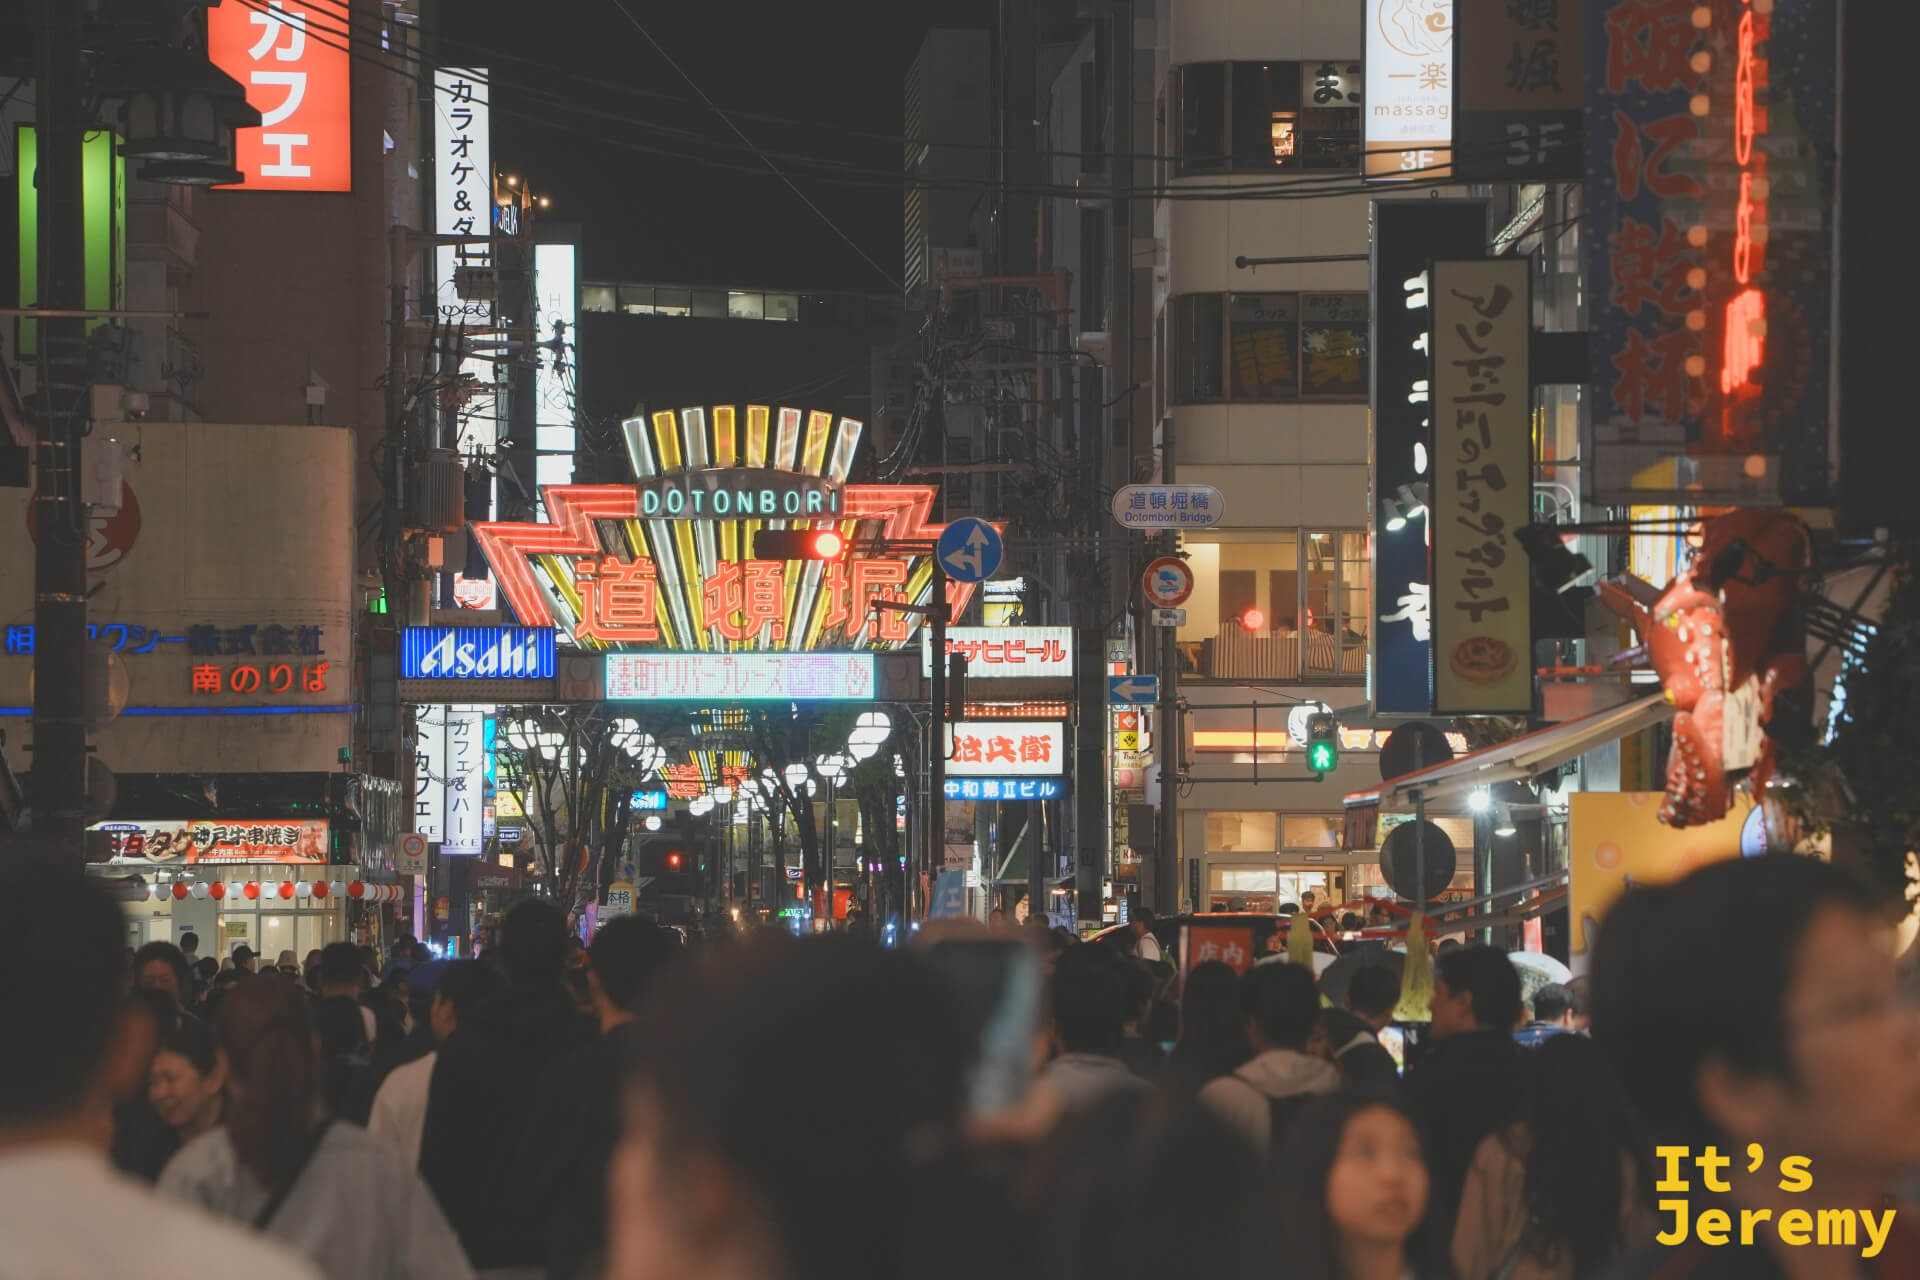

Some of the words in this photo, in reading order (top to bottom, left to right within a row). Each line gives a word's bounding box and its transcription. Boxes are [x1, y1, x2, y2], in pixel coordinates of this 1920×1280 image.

[248, 0, 311, 178] カフェ
[1387, 62, 1449, 91] 一楽
[1401, 149, 1436, 171] 3F
[1450, 283, 1513, 624] アンドリューのエッグタルト
[642, 487, 839, 515] DOTONBORI
[1129, 491, 1209, 510] 道頓堀橋
[1180, 511, 1213, 522] Bridge
[575, 556, 908, 641] 道頓堀
[5, 624, 326, 656] 相クシー株式会社
[420, 630, 538, 677] Asahi
[191, 661, 330, 695] 南のりば
